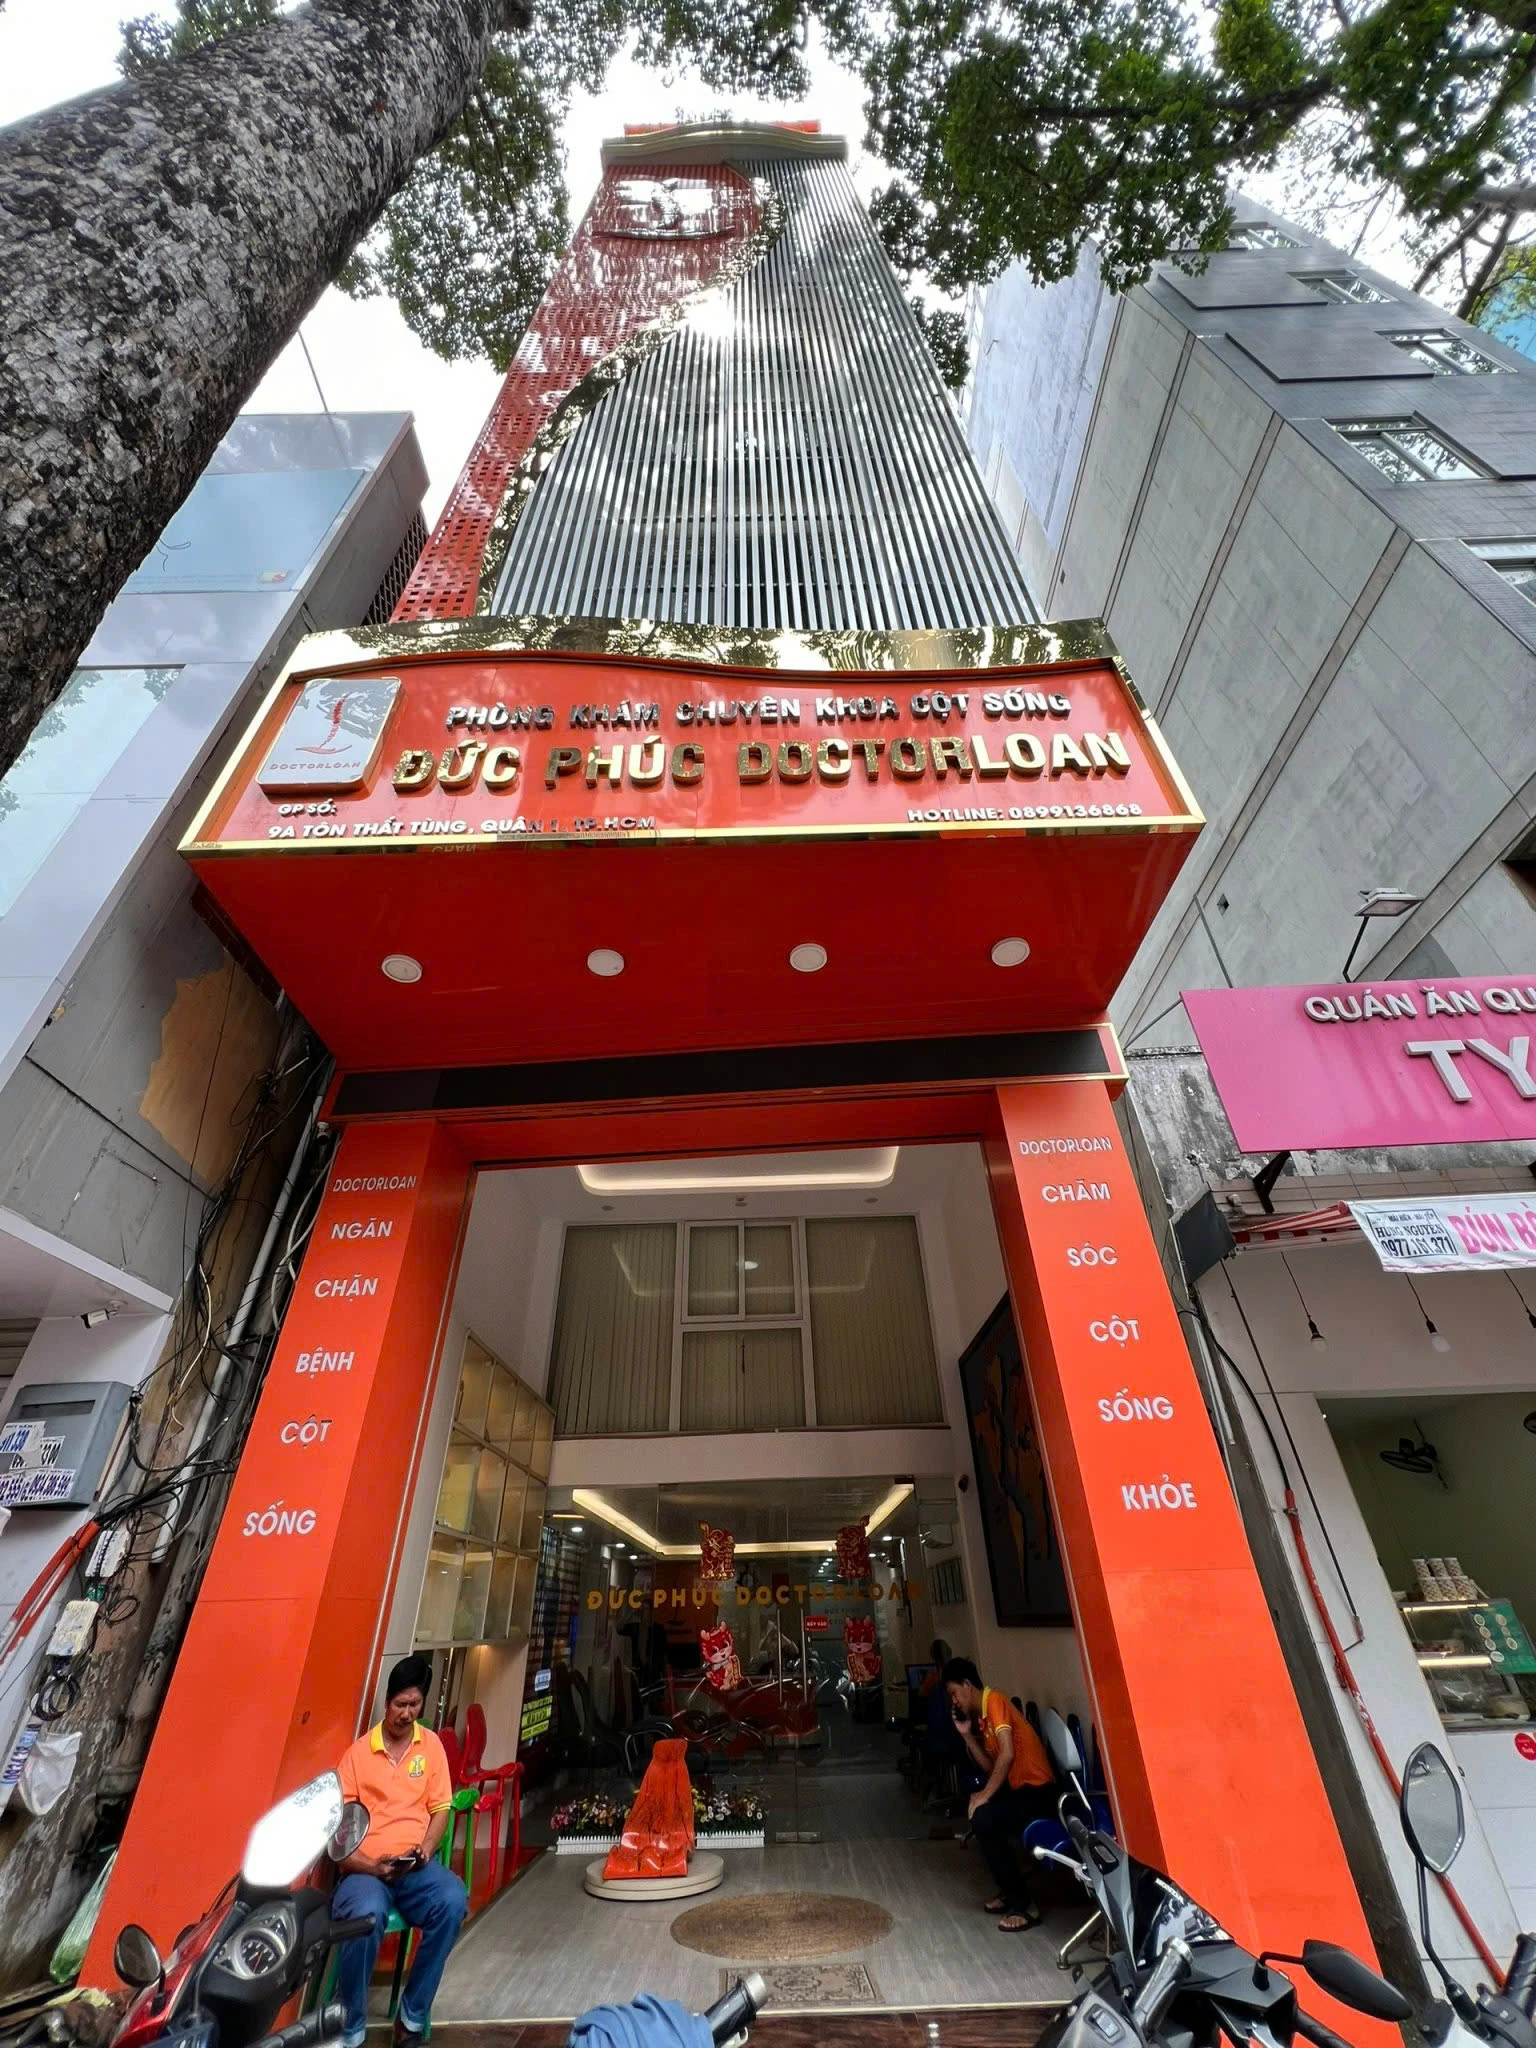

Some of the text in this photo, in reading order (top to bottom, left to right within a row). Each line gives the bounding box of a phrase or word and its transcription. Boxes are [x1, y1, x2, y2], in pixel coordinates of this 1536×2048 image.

[446, 687, 1071, 729] PHÒNG KHÁM CHUYÊN KHOA CỘT SỐNG
[269, 761, 361, 770] DOCTORLOAN
[392, 731, 1131, 791] ĐỨC PHÚC DOCTORLOAN
[278, 804, 305, 816] GP
[908, 803, 1143, 823] HOTLINE: 0899136868
[268, 825, 296, 840] 9A
[303, 822, 345, 838] TÔN
[353, 815, 404, 837] THẤT
[1304, 988, 1418, 1023] QUÁN
[1420, 985, 1482, 1017] ĂN
[1404, 1035, 1536, 1103] TY
[1019, 1136, 1113, 1156] DOCTORLOAN
[332, 1175, 417, 1193] DOCTORLOAN
[1041, 1178, 1111, 1203] CHĂM
[330, 1217, 393, 1240] NGĂN
[1447, 1206, 1520, 1254] BÚN
[1066, 1242, 1118, 1267] SÓC
[313, 1273, 379, 1302] CHẶN
[1089, 1314, 1140, 1347] CỘT
[295, 1346, 355, 1379] BỆNH
[1097, 1387, 1175, 1422] SỐNG
[280, 1413, 333, 1448] CỘT
[1120, 1473, 1198, 1511] KHỎE
[242, 1498, 317, 1537] SỐNG
